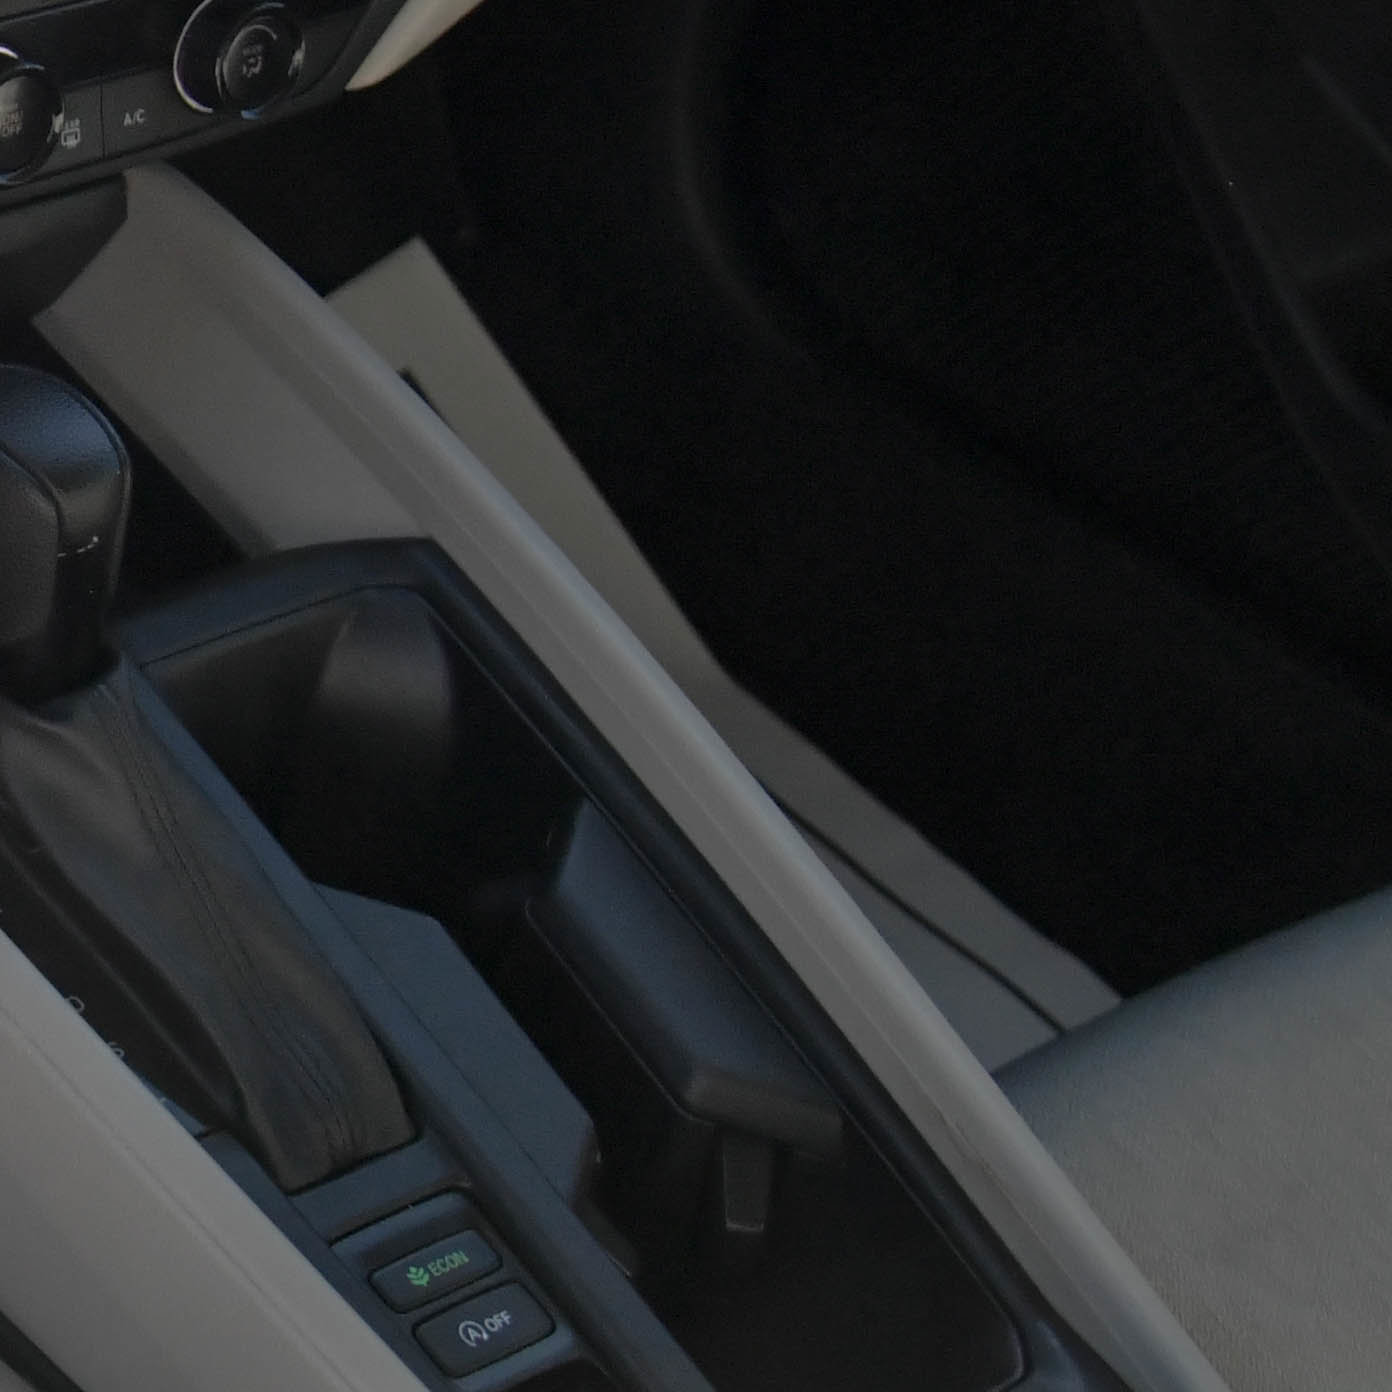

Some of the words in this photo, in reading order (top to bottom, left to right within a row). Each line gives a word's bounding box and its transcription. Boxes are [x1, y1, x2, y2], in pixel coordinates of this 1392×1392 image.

[123, 108, 147, 127] A/C
[427, 1251, 469, 1276] ECON
[484, 1310, 511, 1332] OFF
